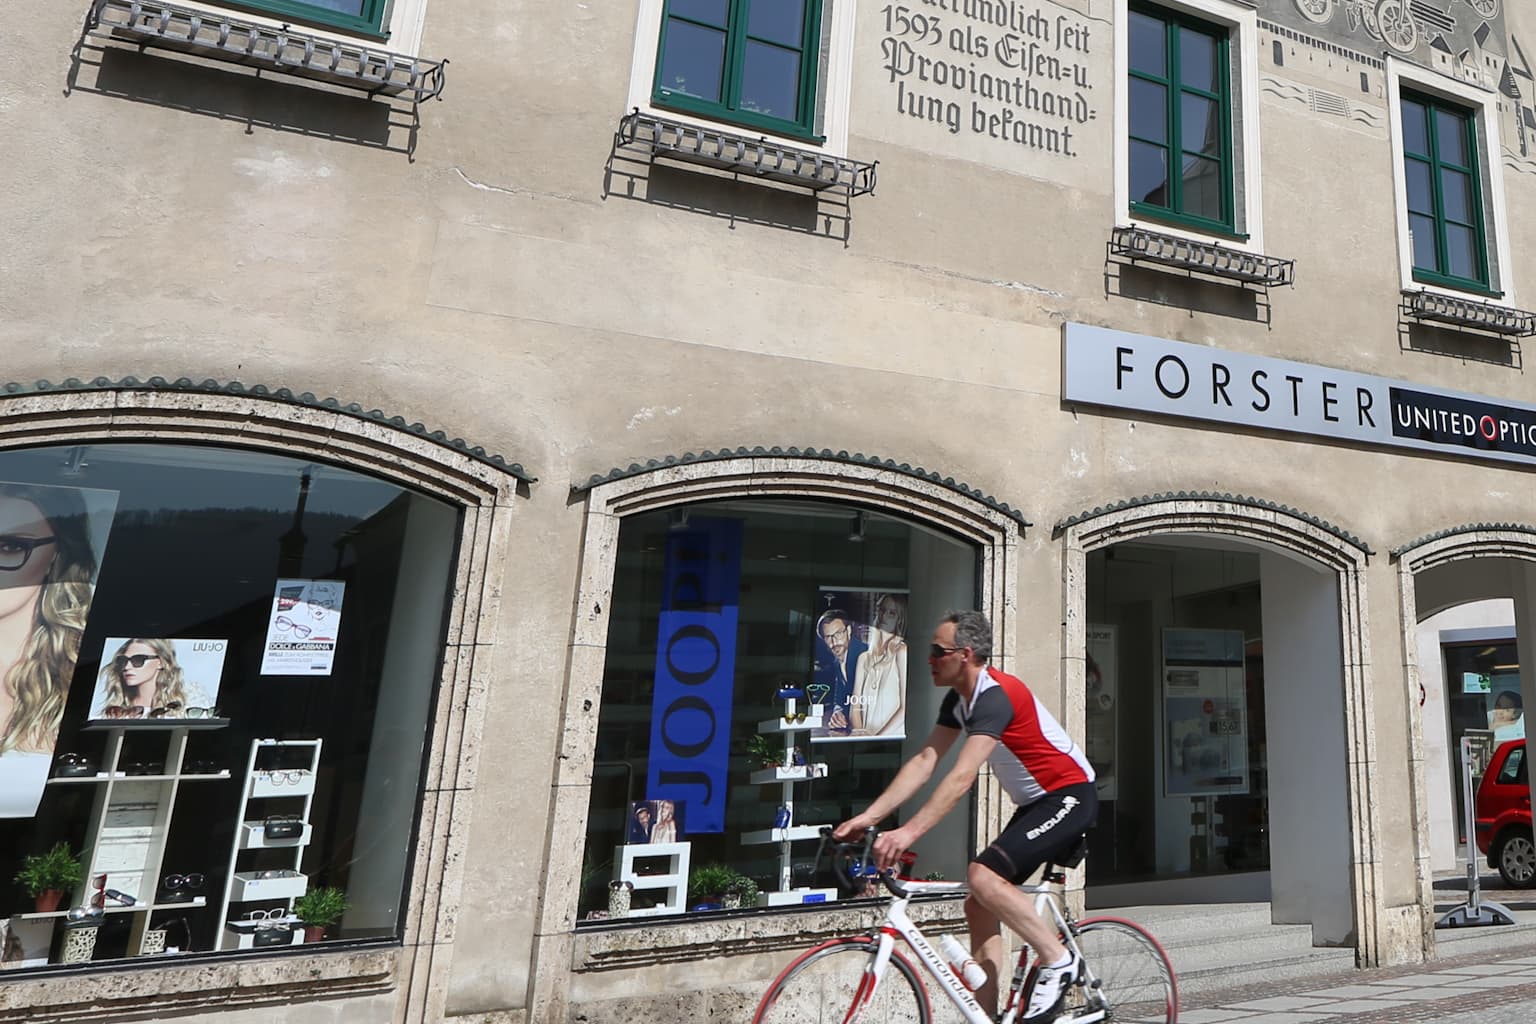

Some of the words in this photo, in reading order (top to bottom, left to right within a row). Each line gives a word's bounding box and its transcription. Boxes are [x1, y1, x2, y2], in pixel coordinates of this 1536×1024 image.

[880, 5, 943, 46] 1593
[949, 25, 989, 61] als
[897, 80, 961, 133] lung
[971, 101, 1078, 158] bekannt.
[1116, 346, 1376, 428] FORSTER
[1026, 800, 1080, 840] ENDURA
[908, 929, 980, 1013] cannondale
